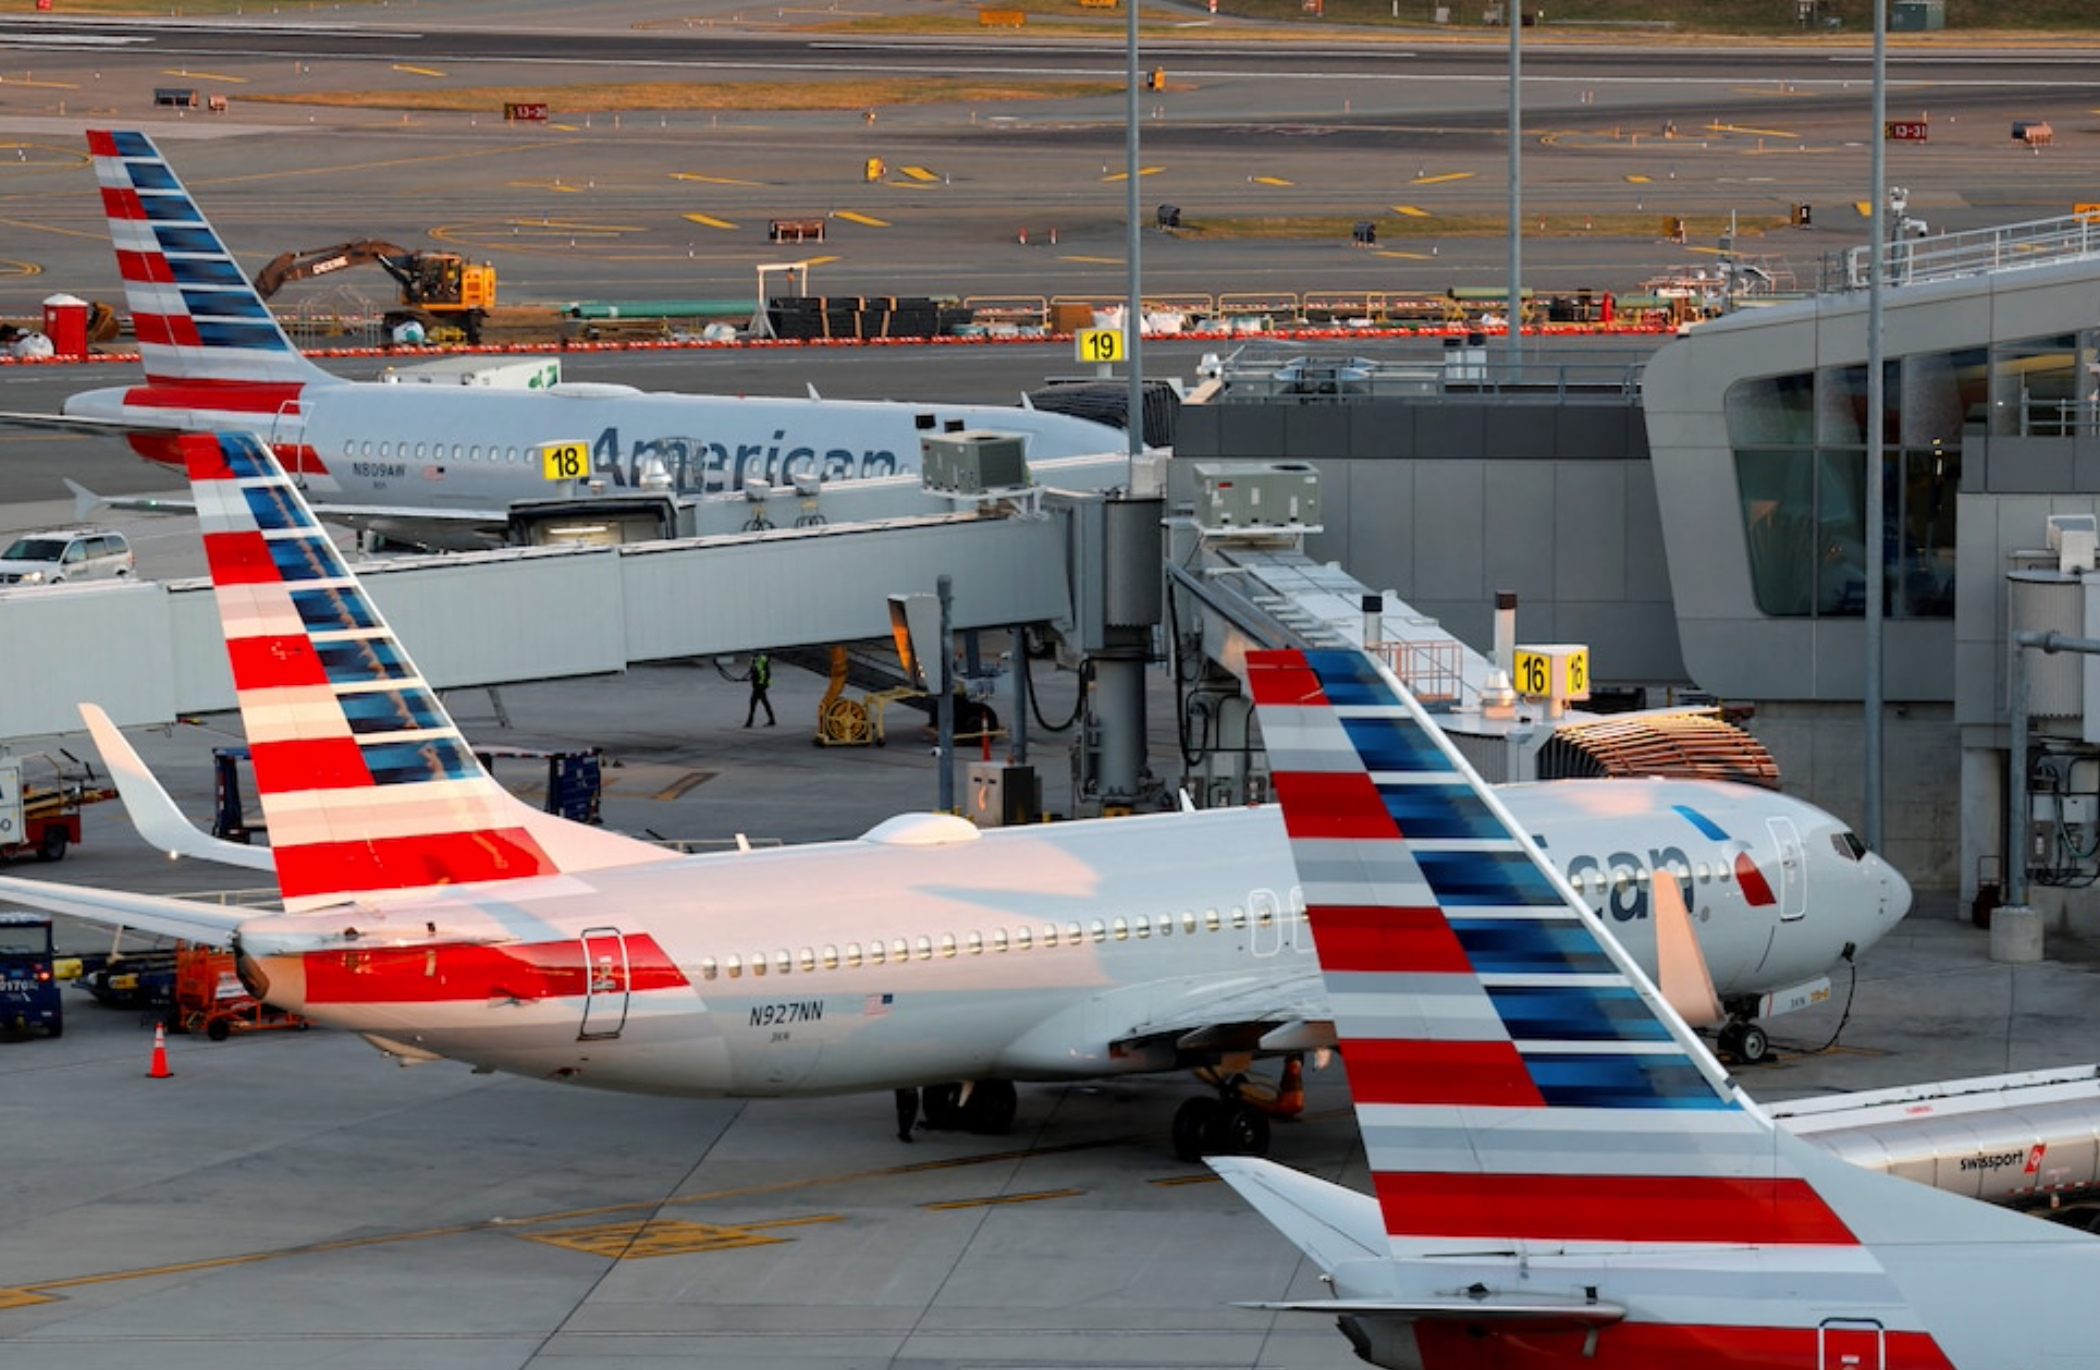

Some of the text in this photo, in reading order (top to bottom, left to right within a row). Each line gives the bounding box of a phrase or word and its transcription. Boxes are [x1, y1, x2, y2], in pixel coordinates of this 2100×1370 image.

[1088, 332, 1115, 360] 19
[551, 447, 580, 477] 18
[1522, 656, 1545, 693] 16
[1570, 654, 1583, 691] 16
[749, 999, 824, 1027] N927NN
[1960, 1150, 2024, 1172] swissport
